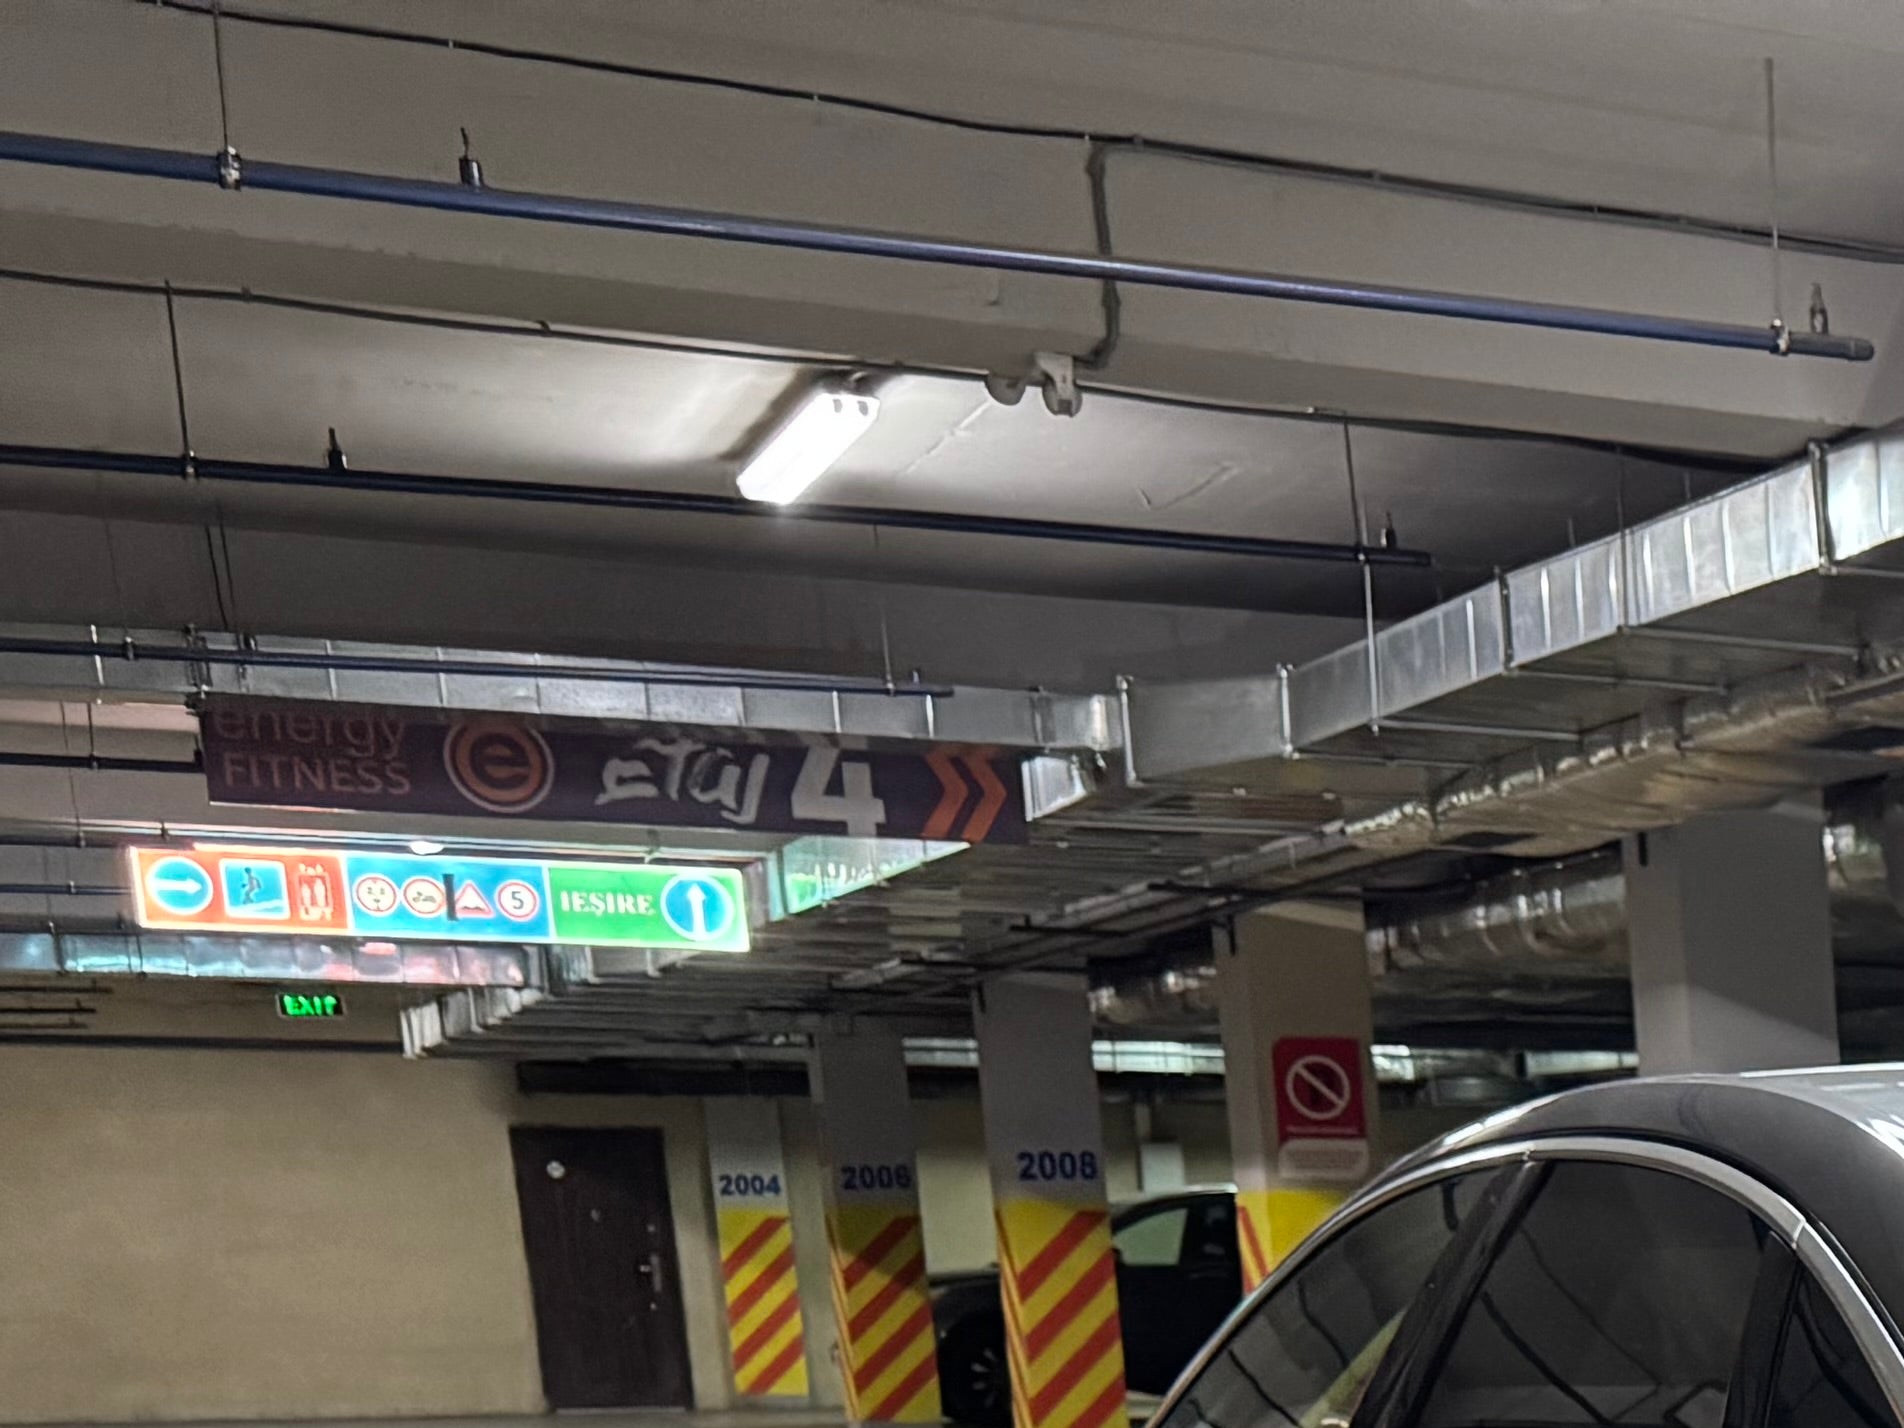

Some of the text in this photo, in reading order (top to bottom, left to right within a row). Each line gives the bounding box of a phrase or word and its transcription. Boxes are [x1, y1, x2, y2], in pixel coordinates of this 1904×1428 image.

[223, 752, 410, 796] FITNESS
[790, 740, 887, 836] 4
[509, 890, 525, 911] 5
[1016, 1150, 1098, 1181] 2008
[718, 1174, 781, 1196] 2004
